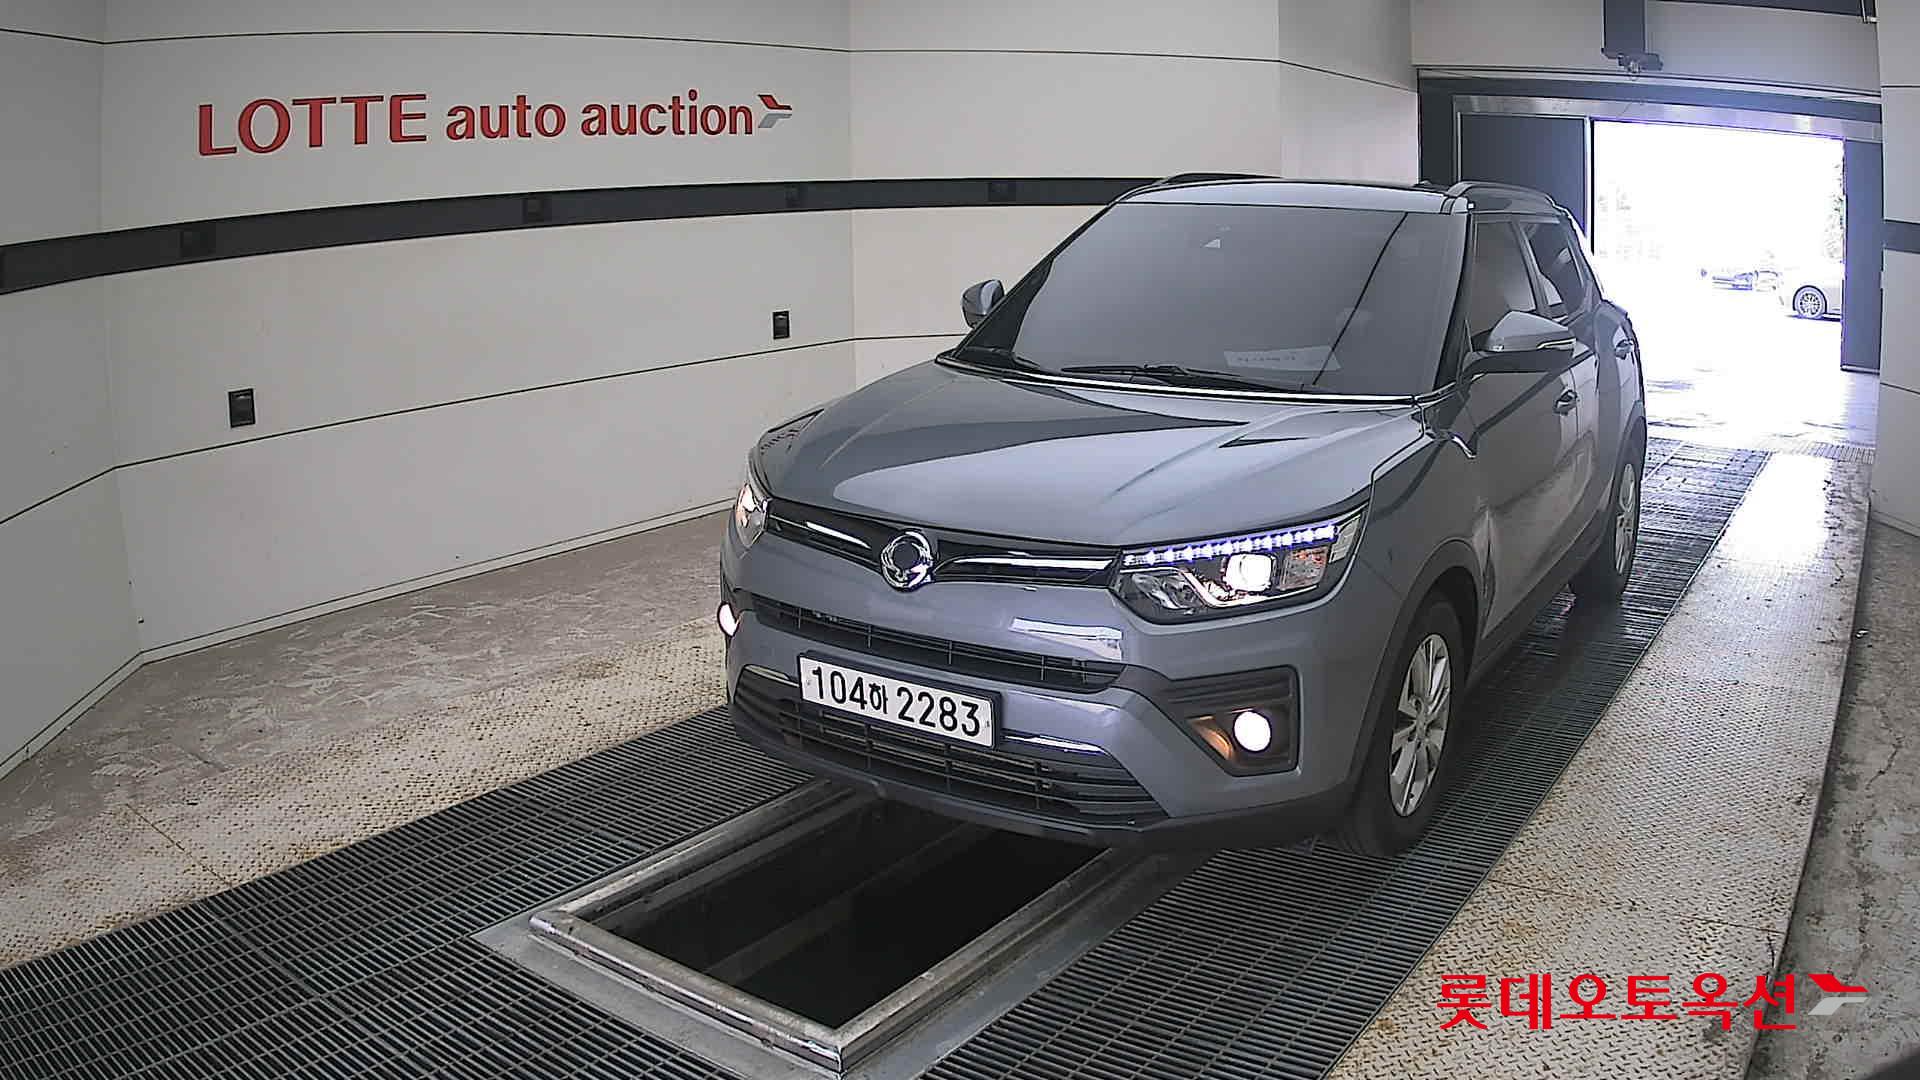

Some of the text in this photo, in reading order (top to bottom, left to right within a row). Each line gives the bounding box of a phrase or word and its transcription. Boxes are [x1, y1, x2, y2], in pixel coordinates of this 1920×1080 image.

[198, 89, 754, 156] LOTTE auto auction
[812, 666, 980, 737] 104하 2283
